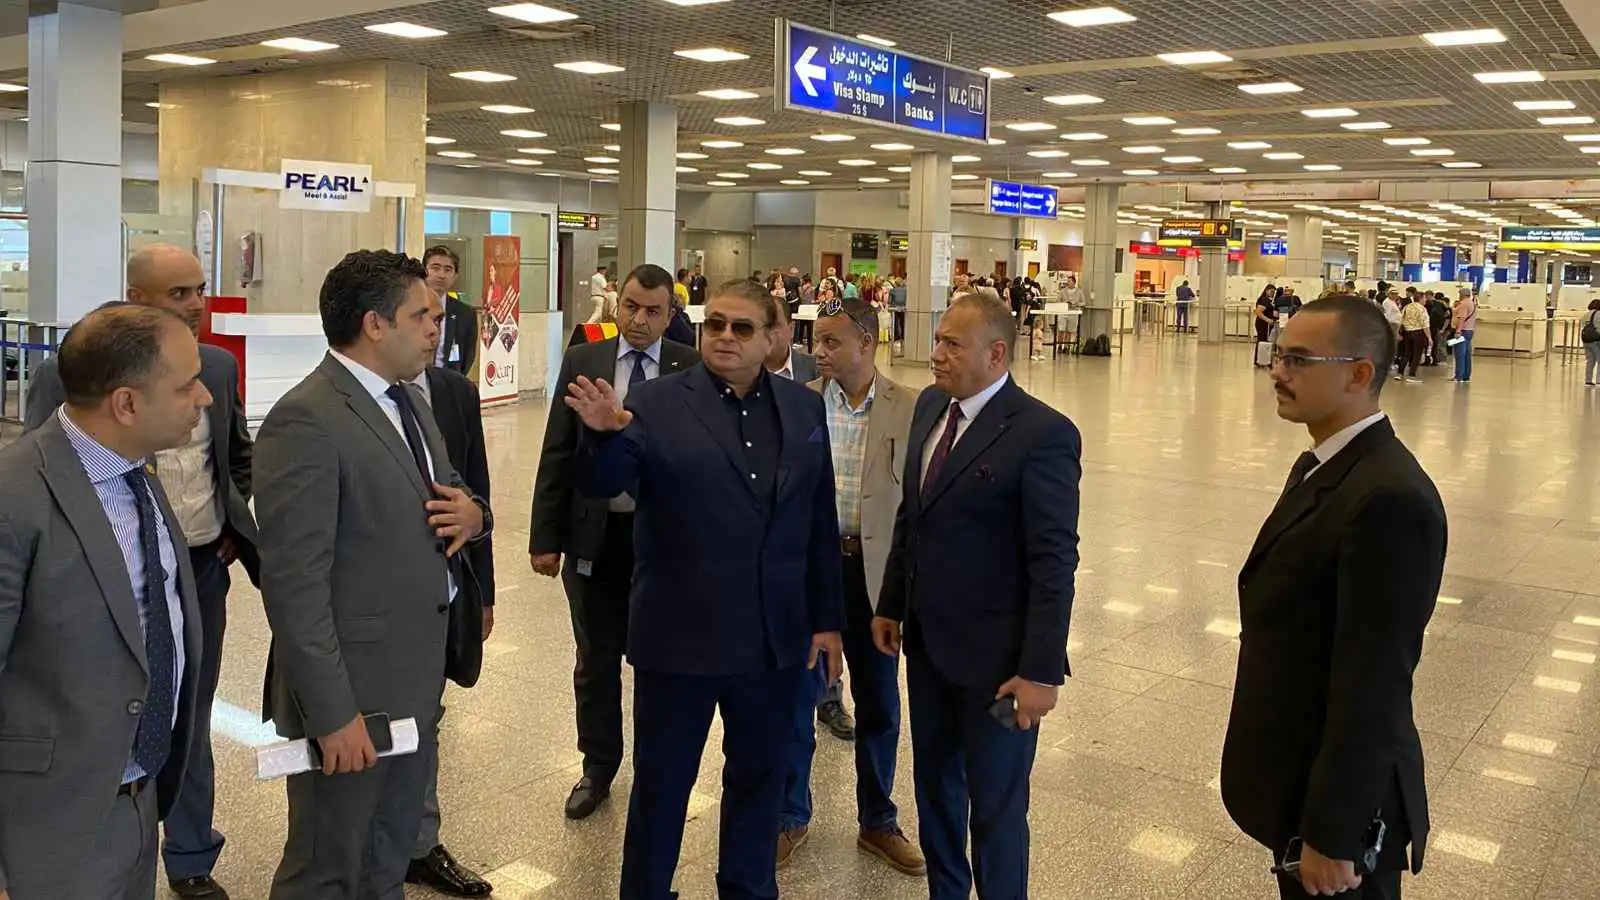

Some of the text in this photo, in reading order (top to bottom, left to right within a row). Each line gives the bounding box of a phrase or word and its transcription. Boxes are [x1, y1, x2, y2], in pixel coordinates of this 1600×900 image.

[829, 45, 859, 65] الدخول
[833, 81, 885, 109] Visa Stamp
[949, 86, 968, 107] W.C
[852, 103, 868, 117] 25 $
[904, 102, 935, 122] Banks
[285, 172, 364, 193] PEARL
[304, 191, 321, 199] Meet
[329, 192, 348, 200] Assist
